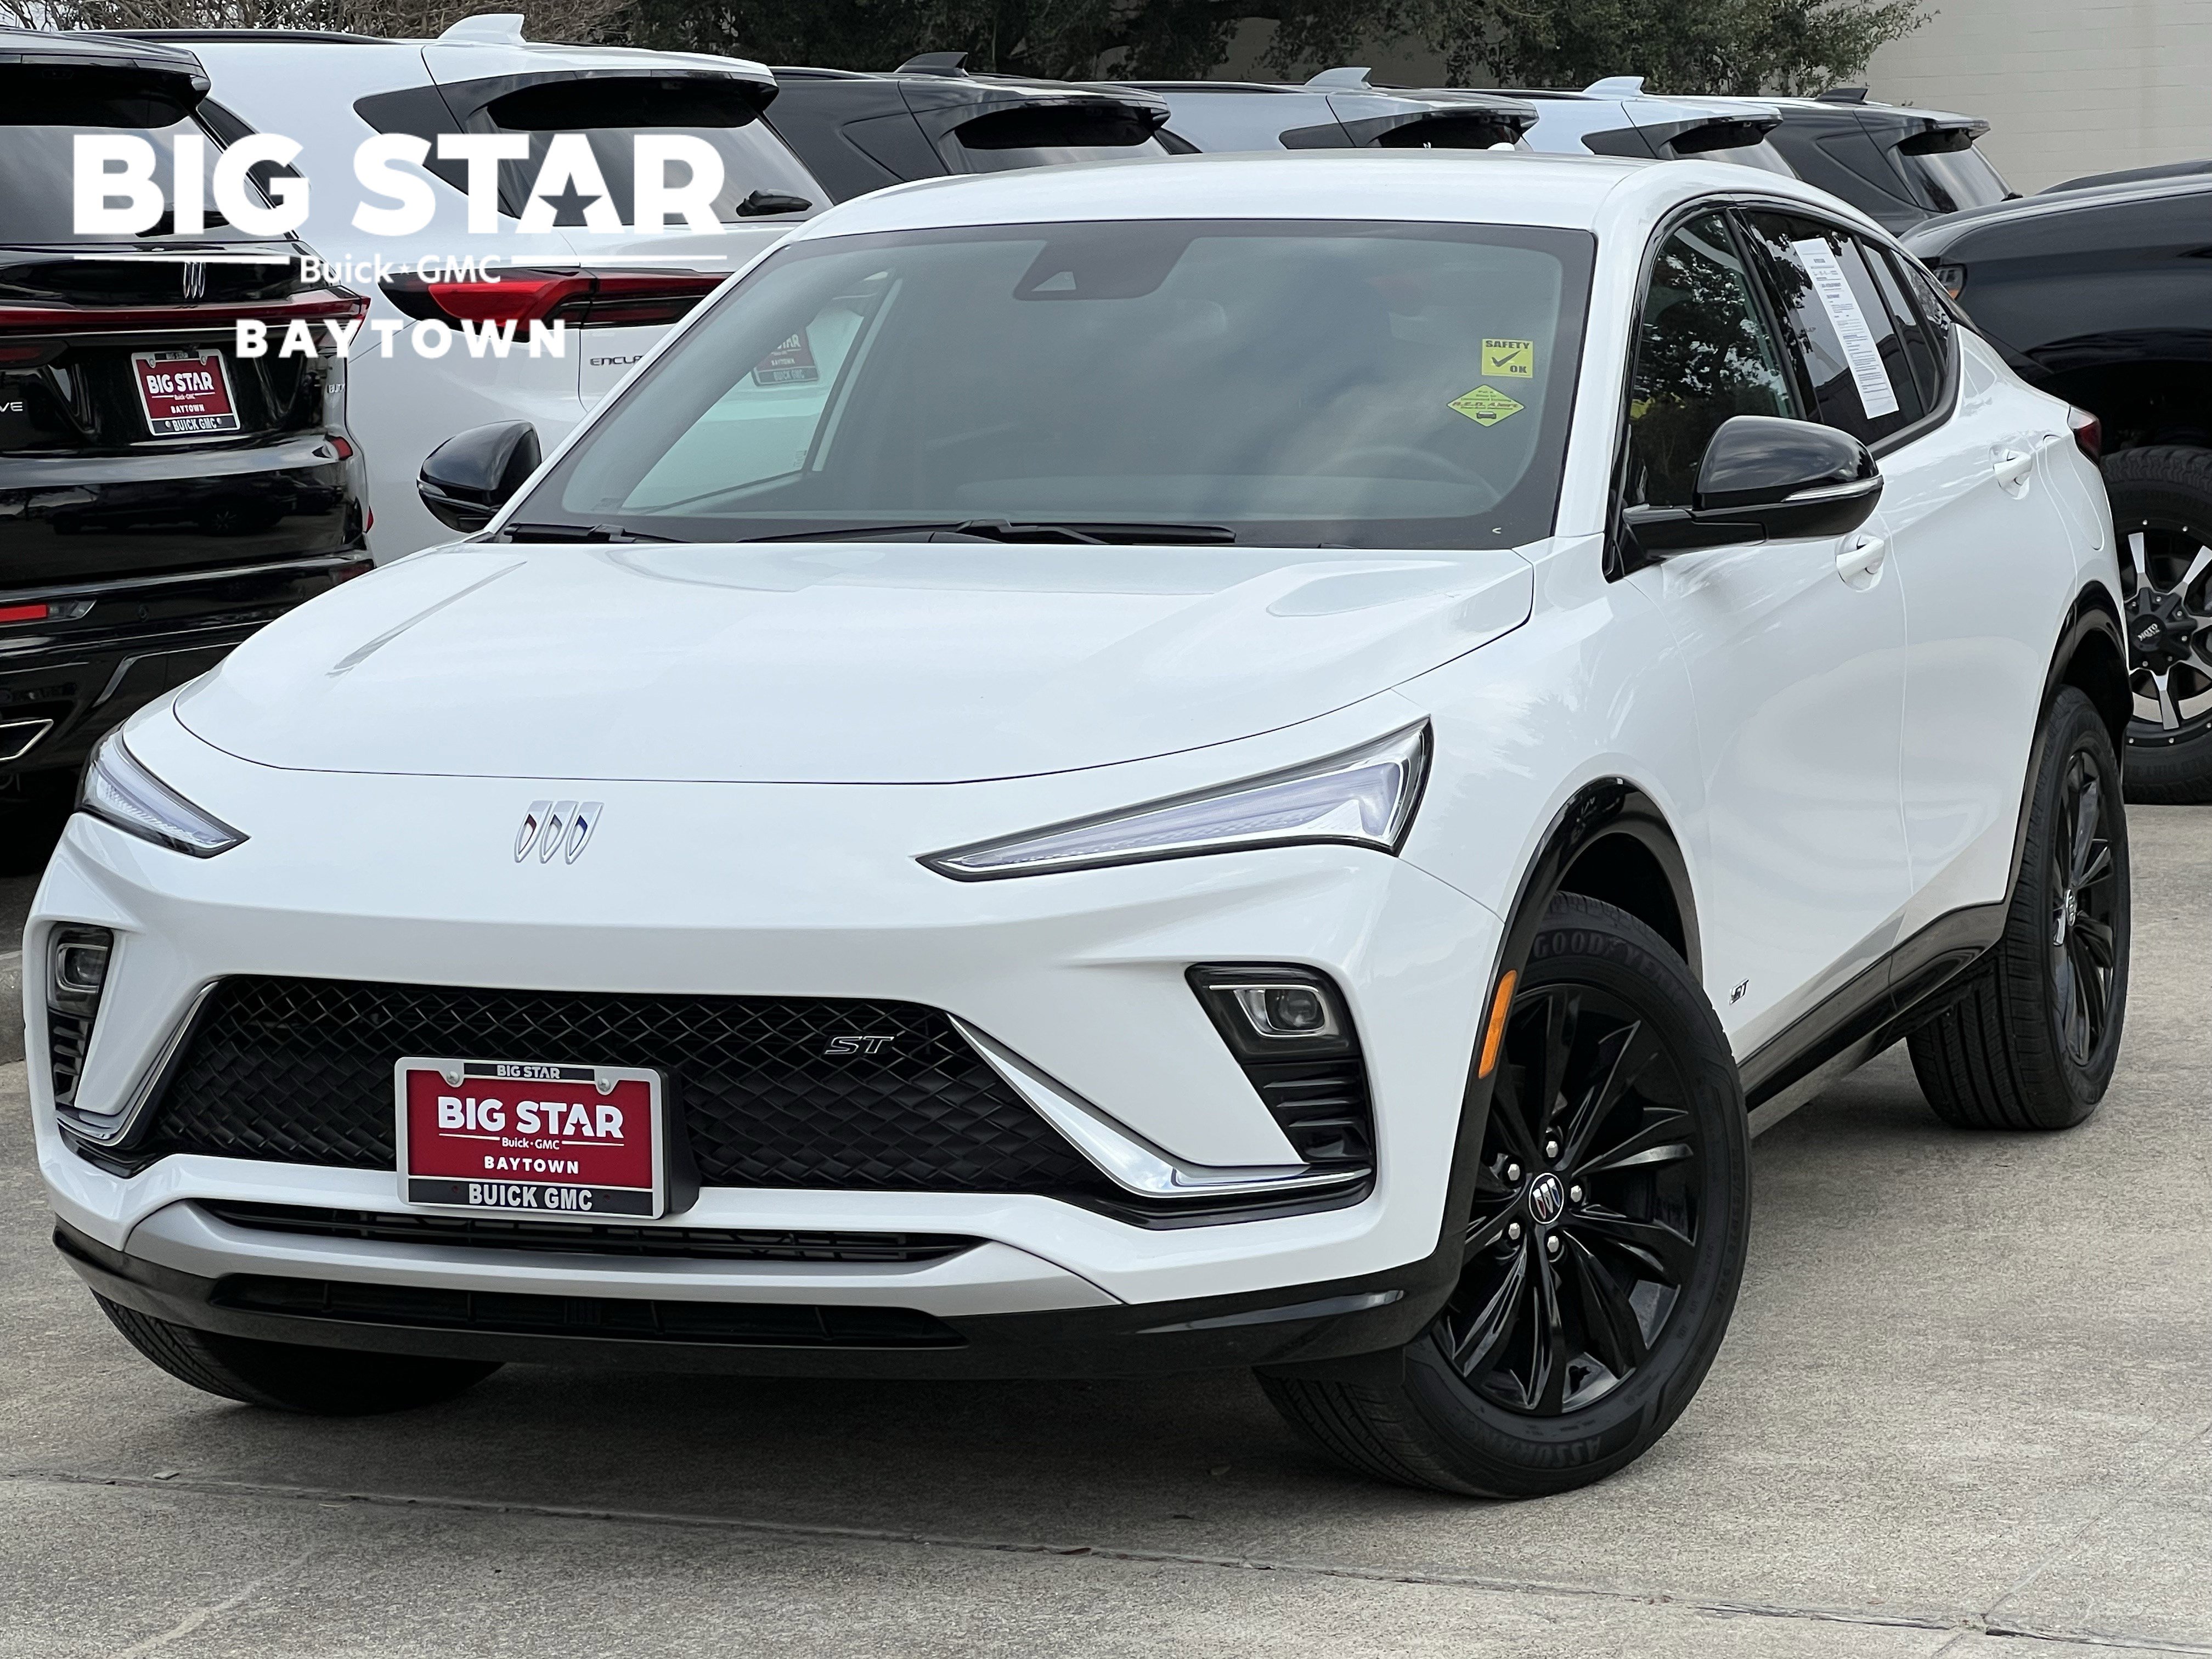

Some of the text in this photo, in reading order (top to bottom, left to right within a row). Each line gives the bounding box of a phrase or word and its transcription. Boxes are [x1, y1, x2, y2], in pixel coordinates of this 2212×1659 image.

[1485, 340, 1530, 349] SAFETY
[146, 372, 215, 394] BIG STAR
[171, 404, 205, 414] BAYTOWN
[172, 417, 217, 432] BUICK GMC
[824, 1036, 895, 1054] ST
[496, 1065, 560, 1079] BIG STAR
[438, 1096, 624, 1138] BIG STAR
[502, 1136, 560, 1150] Buick GMC
[484, 1156, 579, 1174] BAYTOWN
[469, 1183, 593, 1211] BUICK GMC
